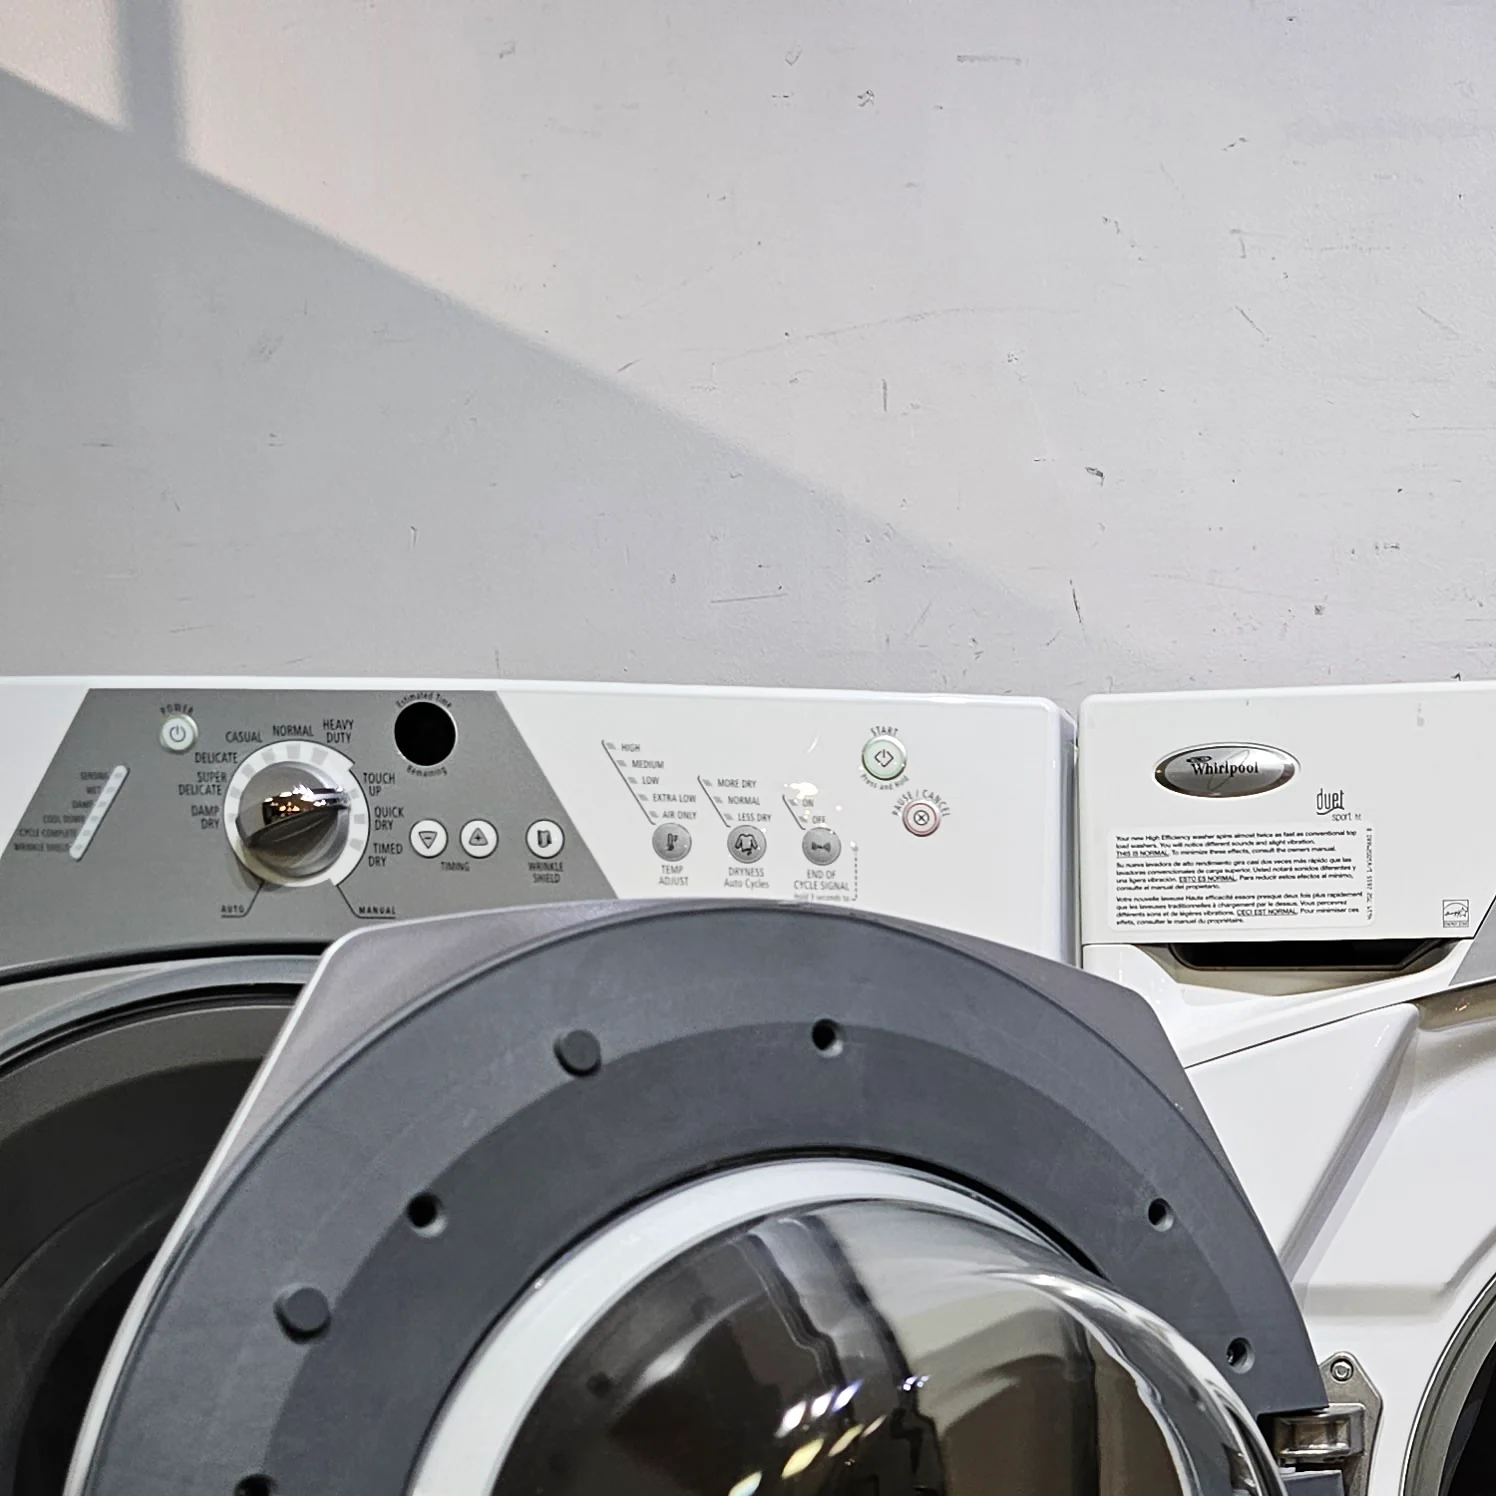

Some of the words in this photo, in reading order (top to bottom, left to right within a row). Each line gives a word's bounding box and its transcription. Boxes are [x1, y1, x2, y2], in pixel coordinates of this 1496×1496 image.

[273, 723, 314, 738] NORMAL
[323, 719, 354, 732] HEAVY
[226, 730, 262, 744] CASUAL
[327, 730, 351, 743] DUTY
[871, 726, 898, 737] START
[621, 742, 640, 752] HIGH
[195, 751, 238, 765] DELICATE
[632, 759, 664, 769] MEDIUM
[1191, 762, 1258, 777] Whirlpool
[197, 771, 227, 783] SUPER
[363, 772, 395, 785] TOUCH
[642, 776, 659, 785] LOW
[718, 778, 739, 788] MORE
[741, 779, 756, 789] DRY
[179, 783, 222, 796] DELICATE
[369, 784, 382, 797] UP
[676, 793, 696, 802] LOW
[728, 796, 760, 805] NORMAL
[802, 799, 814, 807] ON
[1316, 788, 1344, 815] duet
[892, 792, 914, 816] PAUSE
[192, 805, 220, 817] DAMP
[374, 806, 404, 819] QUICK
[662, 810, 675, 819] AIR
[677, 810, 696, 820] ONLY
[738, 813, 755, 822] LESS
[757, 813, 772, 823] DRY
[812, 815, 826, 824] OFF
[1332, 813, 1351, 821] sport
[202, 818, 220, 830] DRY
[374, 818, 393, 831] DRY
[374, 842, 403, 855] TIMED
[368, 855, 387, 867] DRY
[441, 861, 470, 872] TIMING
[528, 861, 563, 872] WRINKLE
[661, 865, 682, 874] TEMP
[729, 867, 764, 876] DRYNESS
[807, 870, 820, 879] END
[823, 870, 835, 879] OF
[533, 872, 560, 883] SHIELD
[659, 876, 688, 886] ADJUST
[794, 880, 818, 890] CYCLE
[820, 881, 849, 891] SIGNAL
[221, 904, 245, 914] AUTO
[359, 905, 396, 915] MANUAL
